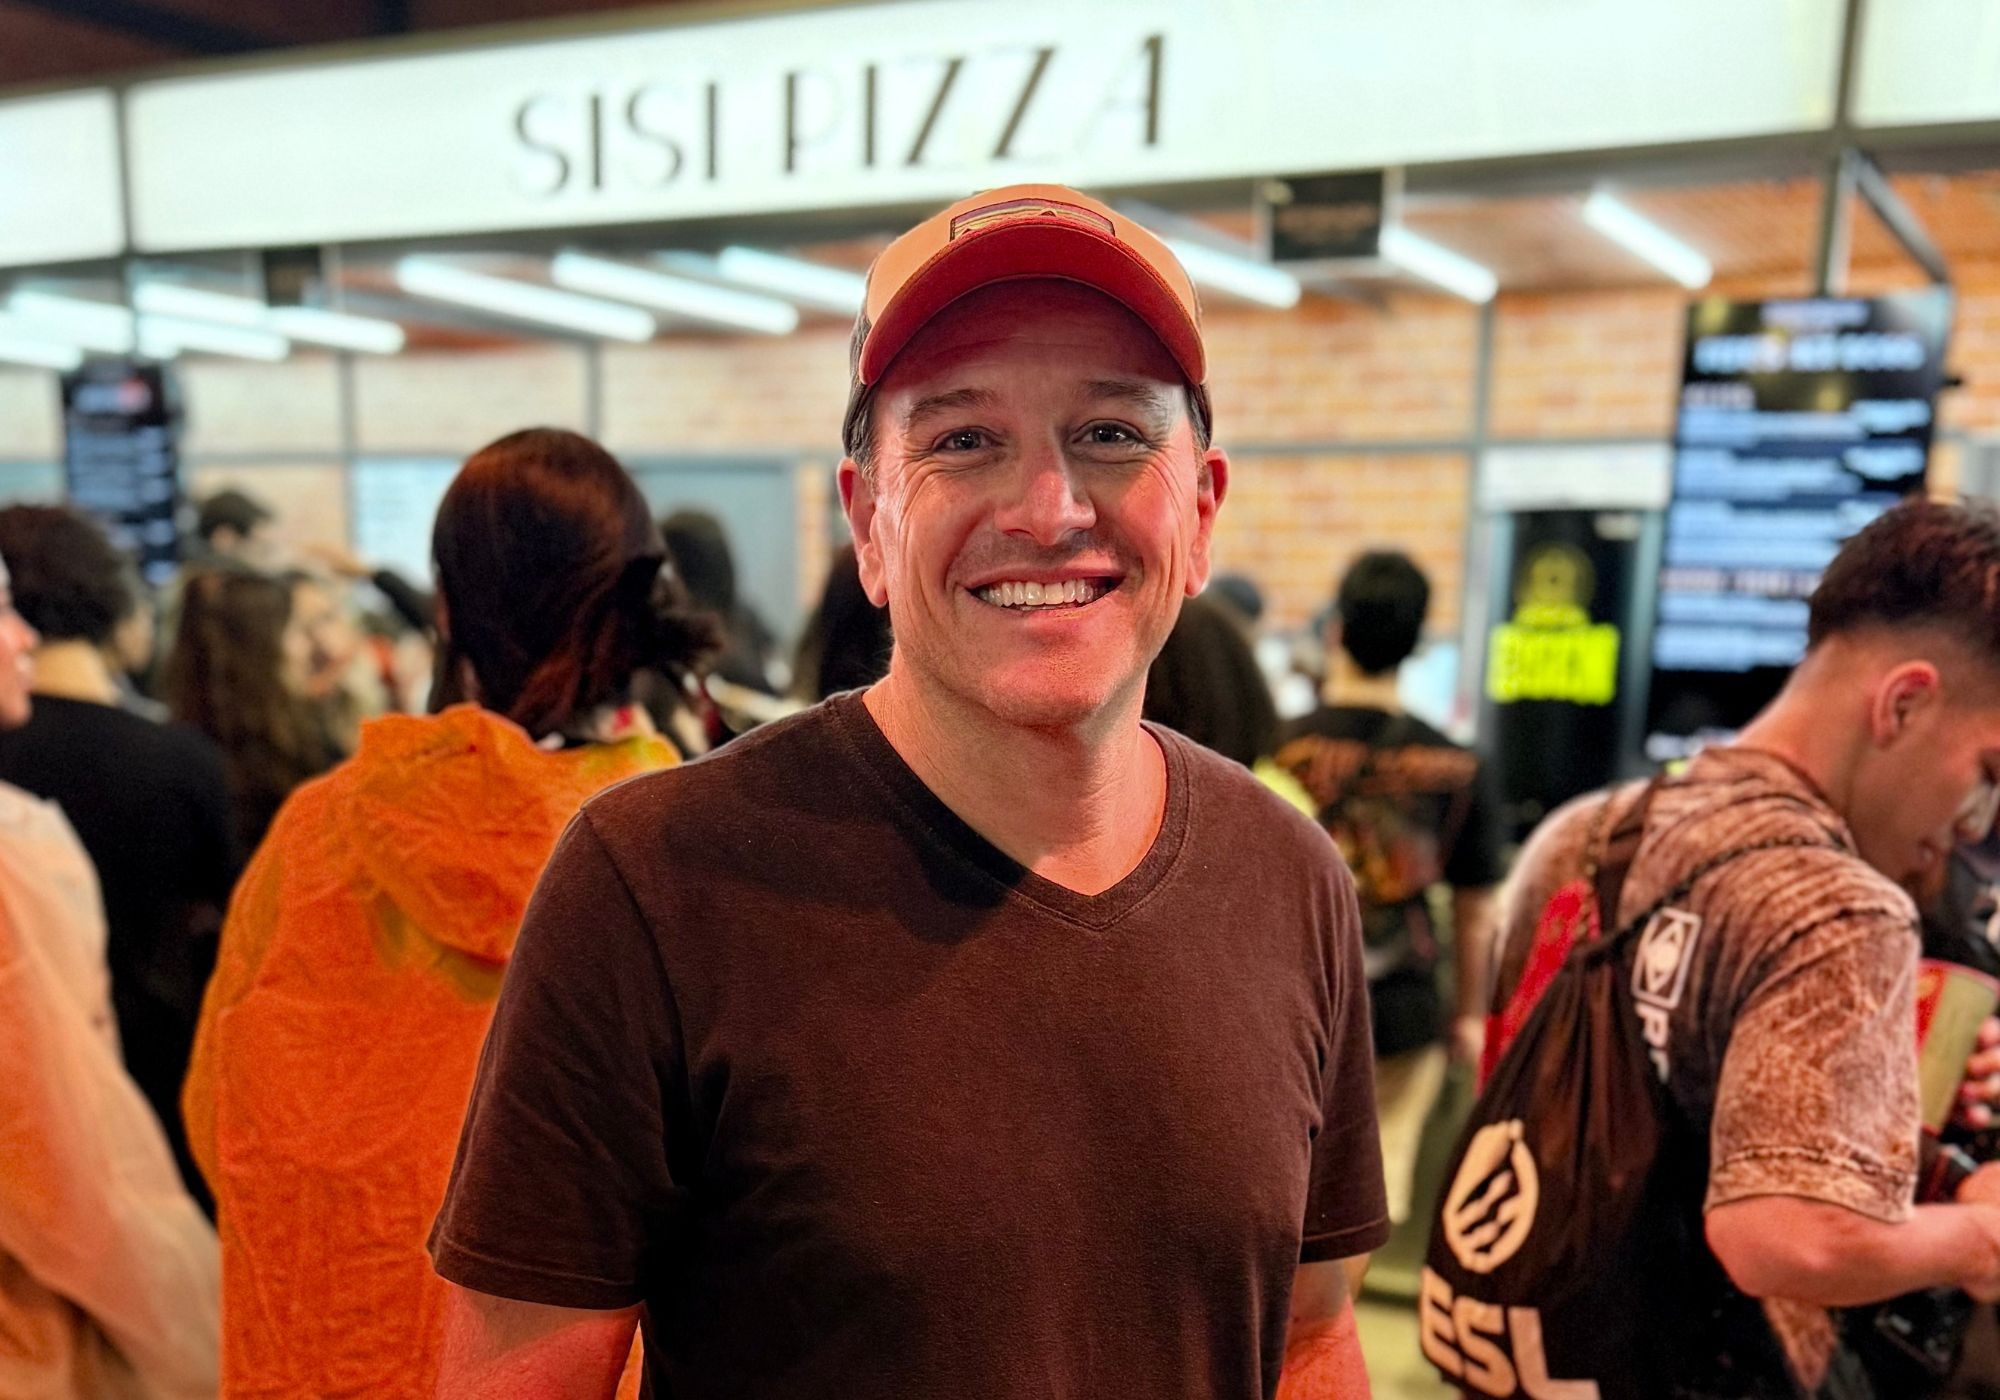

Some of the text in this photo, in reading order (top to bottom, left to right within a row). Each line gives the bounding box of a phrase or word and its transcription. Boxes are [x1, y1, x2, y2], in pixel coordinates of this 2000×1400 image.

[514, 34, 1164, 197] SISI PIZZA
[1419, 1265, 1599, 1400] ESL
